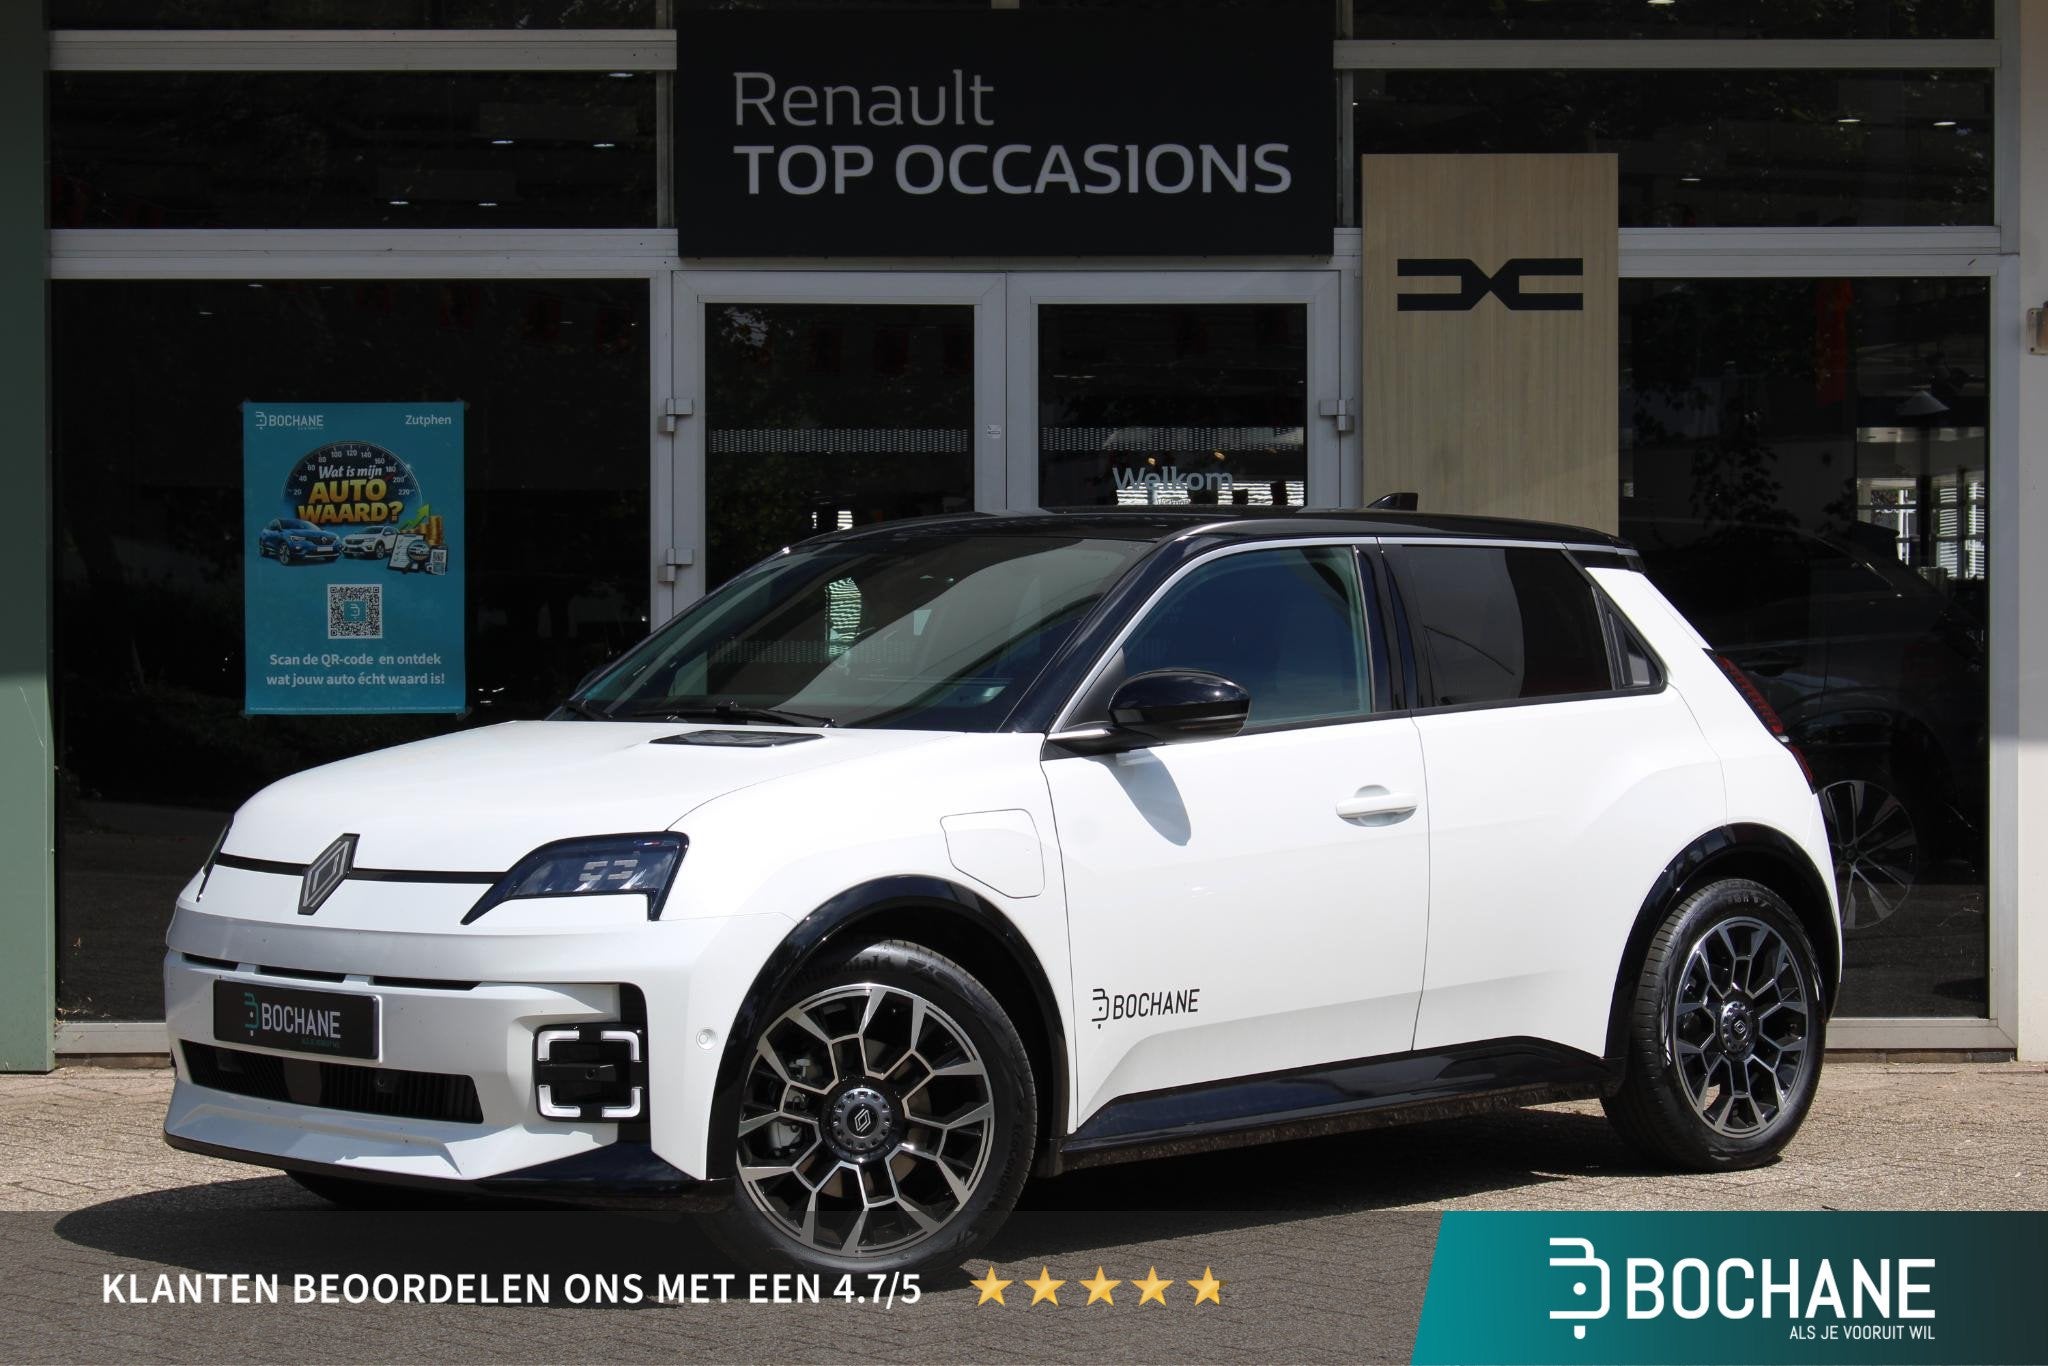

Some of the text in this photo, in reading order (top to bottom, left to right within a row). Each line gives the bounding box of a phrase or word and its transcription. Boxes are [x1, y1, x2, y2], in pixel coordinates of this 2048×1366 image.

[734, 69, 994, 126] Renault
[733, 143, 1292, 195] TOP OCCASIONS
[268, 414, 324, 427] BOCHANE
[405, 415, 452, 428] Zutphen
[319, 464, 383, 480] Wat is mijn
[1112, 466, 1233, 491] Welkom
[307, 479, 388, 504] AUTO
[297, 500, 404, 524] WAARD?
[269, 653, 441, 668] Scan de QR-code en ontdek
[266, 671, 446, 687] wat jouw auto écht waard is!
[1112, 988, 1201, 1020] BOCHANE
[261, 1002, 342, 1039] BOCHANE
